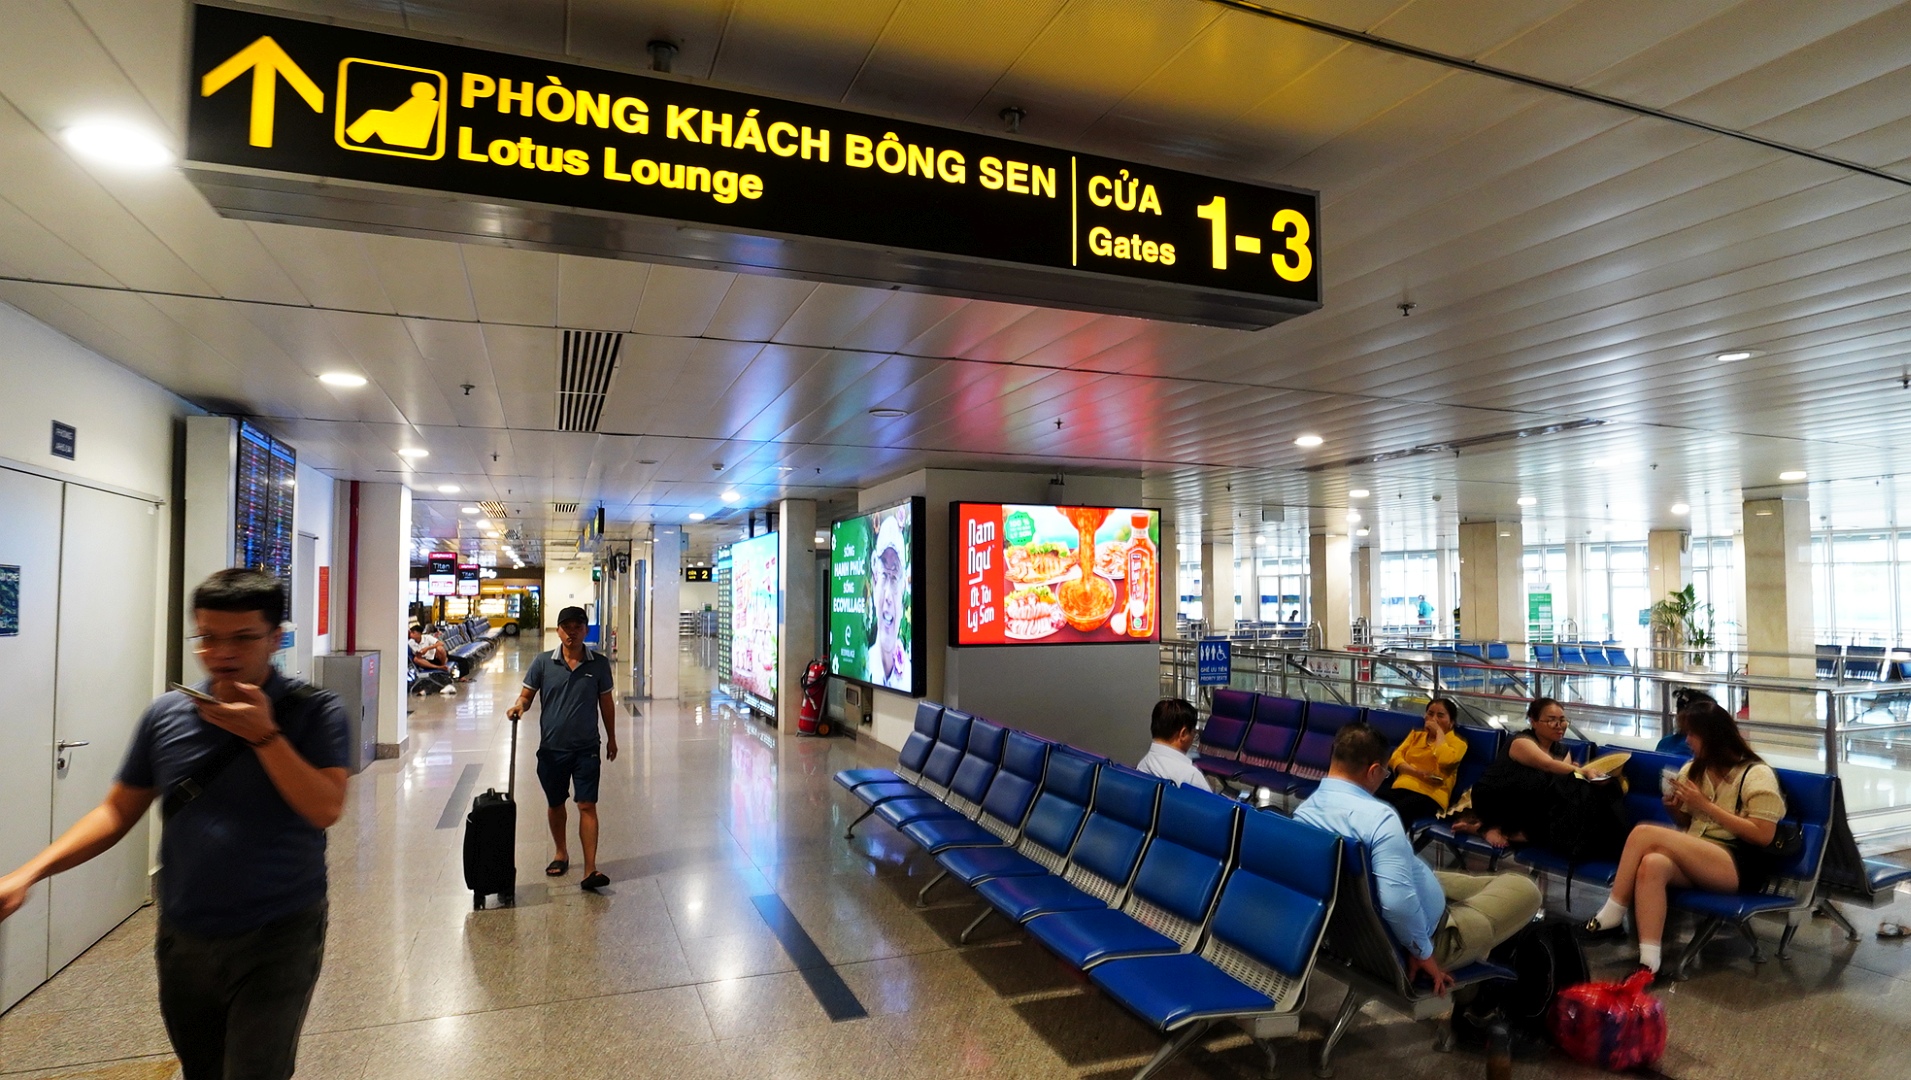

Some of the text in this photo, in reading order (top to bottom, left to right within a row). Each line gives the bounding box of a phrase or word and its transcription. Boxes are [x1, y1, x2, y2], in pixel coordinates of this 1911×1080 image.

[460, 71, 1057, 199] PHÒNG KHÁCH BÔNG SEN
[457, 126, 764, 205] Lotus Lounge
[1087, 168, 1163, 216] CỬA
[1088, 225, 1177, 266] Gates
[968, 518, 995, 547] Nam
[701, 570, 709, 579] 2
[850, 557, 865, 576] PHÚC
[833, 597, 865, 613] ECOVILLAGE
